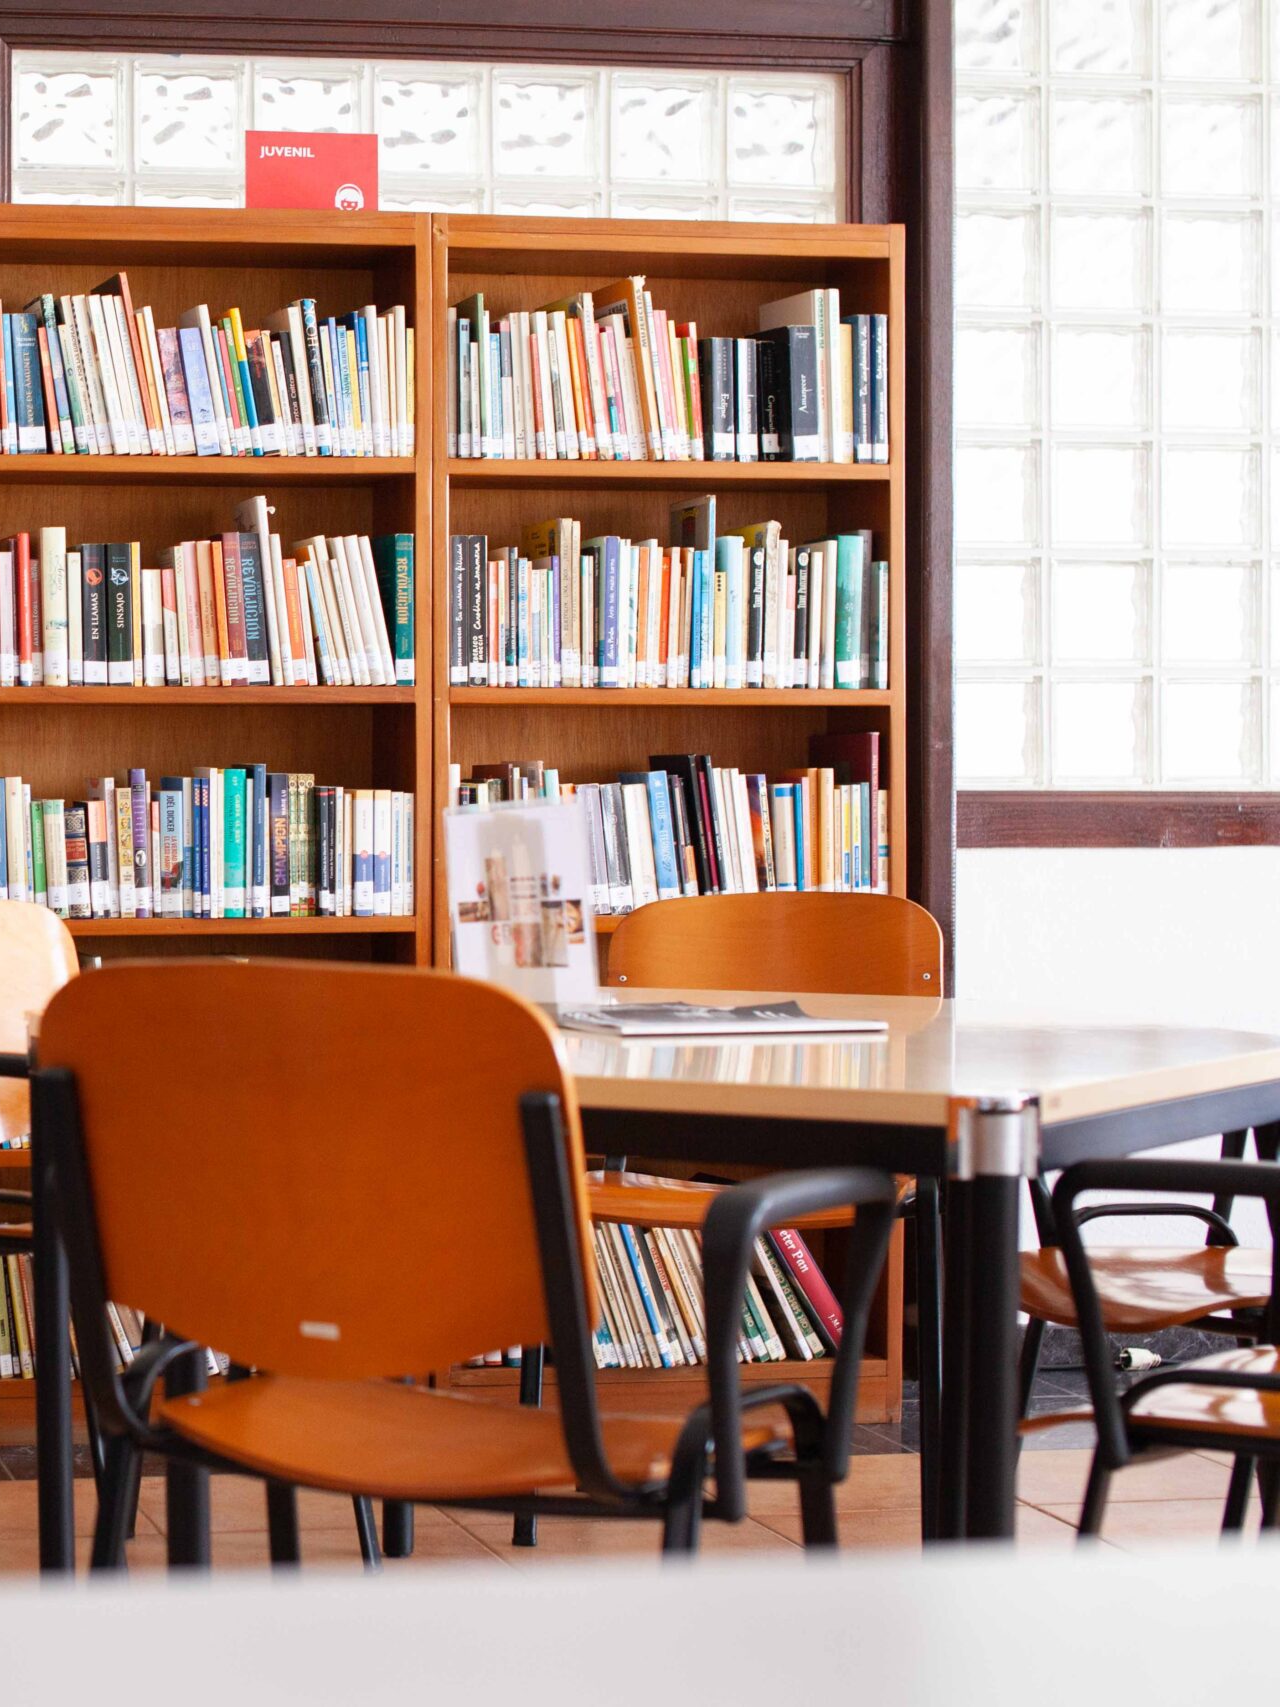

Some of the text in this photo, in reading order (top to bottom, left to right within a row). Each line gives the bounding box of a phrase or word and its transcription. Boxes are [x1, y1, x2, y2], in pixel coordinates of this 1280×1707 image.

[259, 145, 315, 159] JUVENIL
[635, 287, 647, 349] MUJERCITAS
[90, 592, 100, 641] EN LLAMAS
[116, 592, 125, 629] SINSAJO
[472, 591, 483, 630] Carolina
[280, 789, 287, 798] LU
[166, 795, 175, 832] JOËL DICKER
[274, 816, 287, 886] CHAMPION
[778, 1229, 809, 1273] eter Pan
